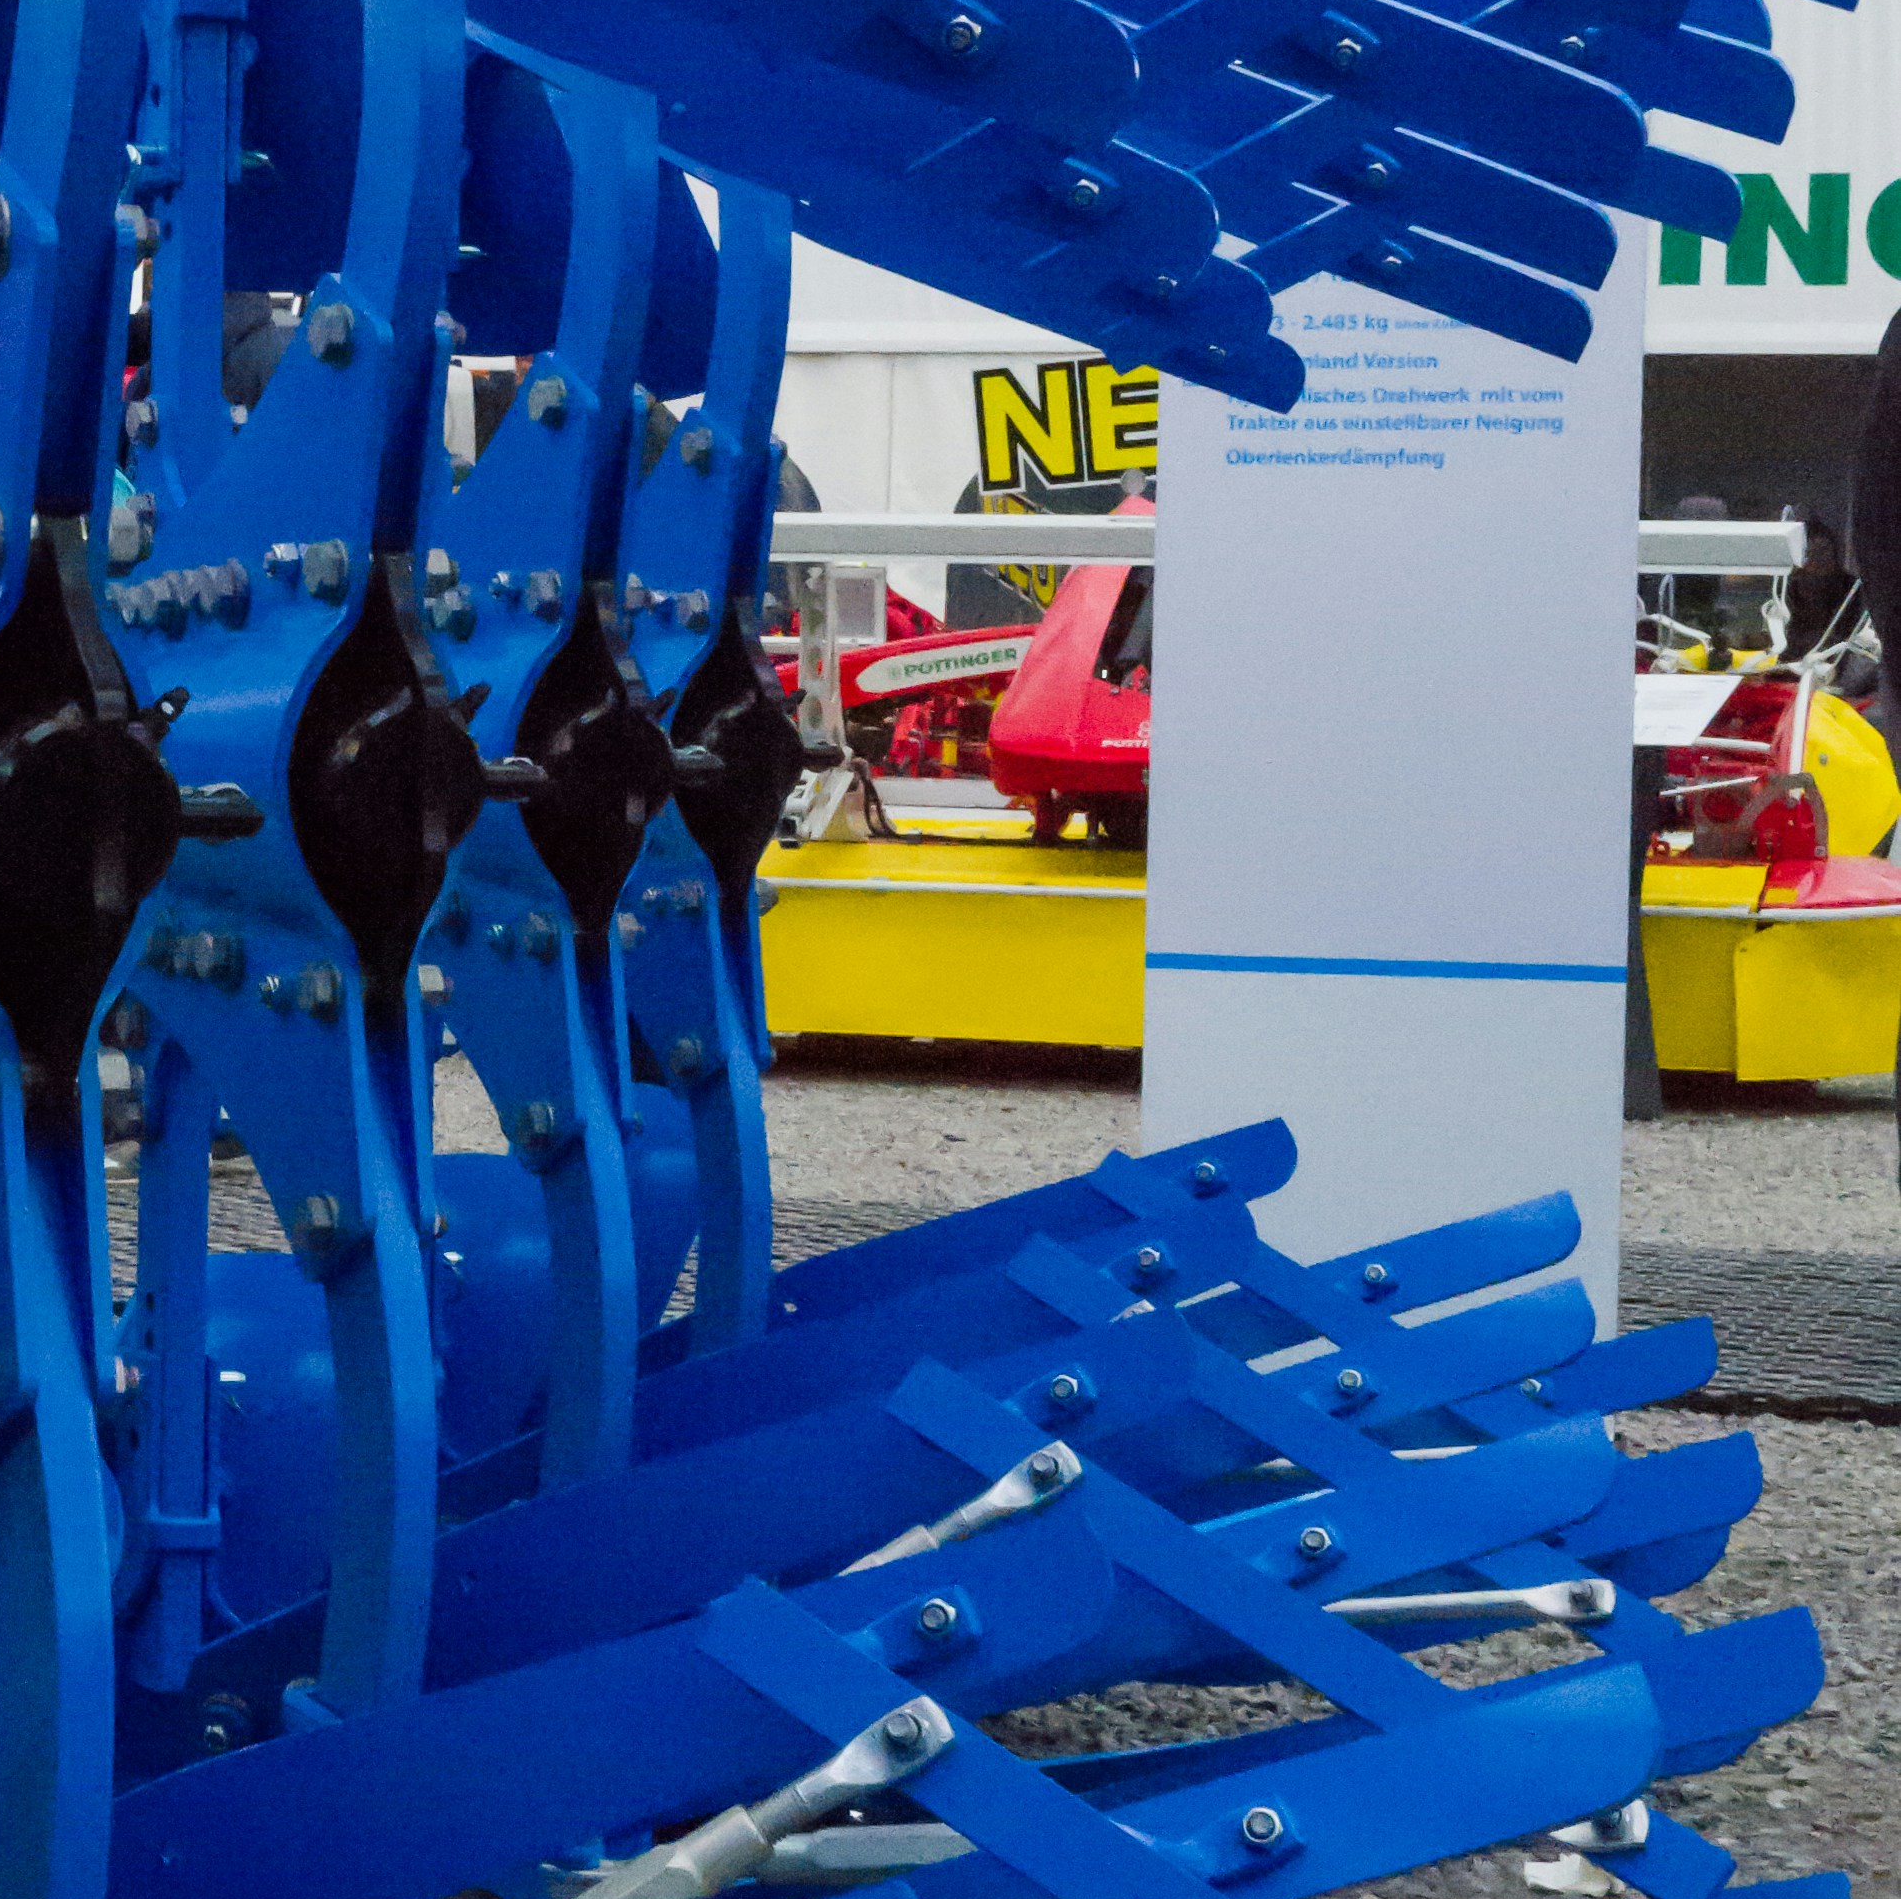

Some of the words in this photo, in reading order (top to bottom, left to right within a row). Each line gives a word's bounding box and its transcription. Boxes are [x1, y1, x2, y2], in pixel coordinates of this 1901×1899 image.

[1364, 314, 1389, 334] kg
[1363, 352, 1439, 369] Version
[1480, 386, 1515, 403] mit
[1520, 389, 1564, 403] vom
[1228, 413, 1298, 431] Traktor
[1304, 417, 1338, 431] aus
[1475, 413, 1564, 435] Neigung
